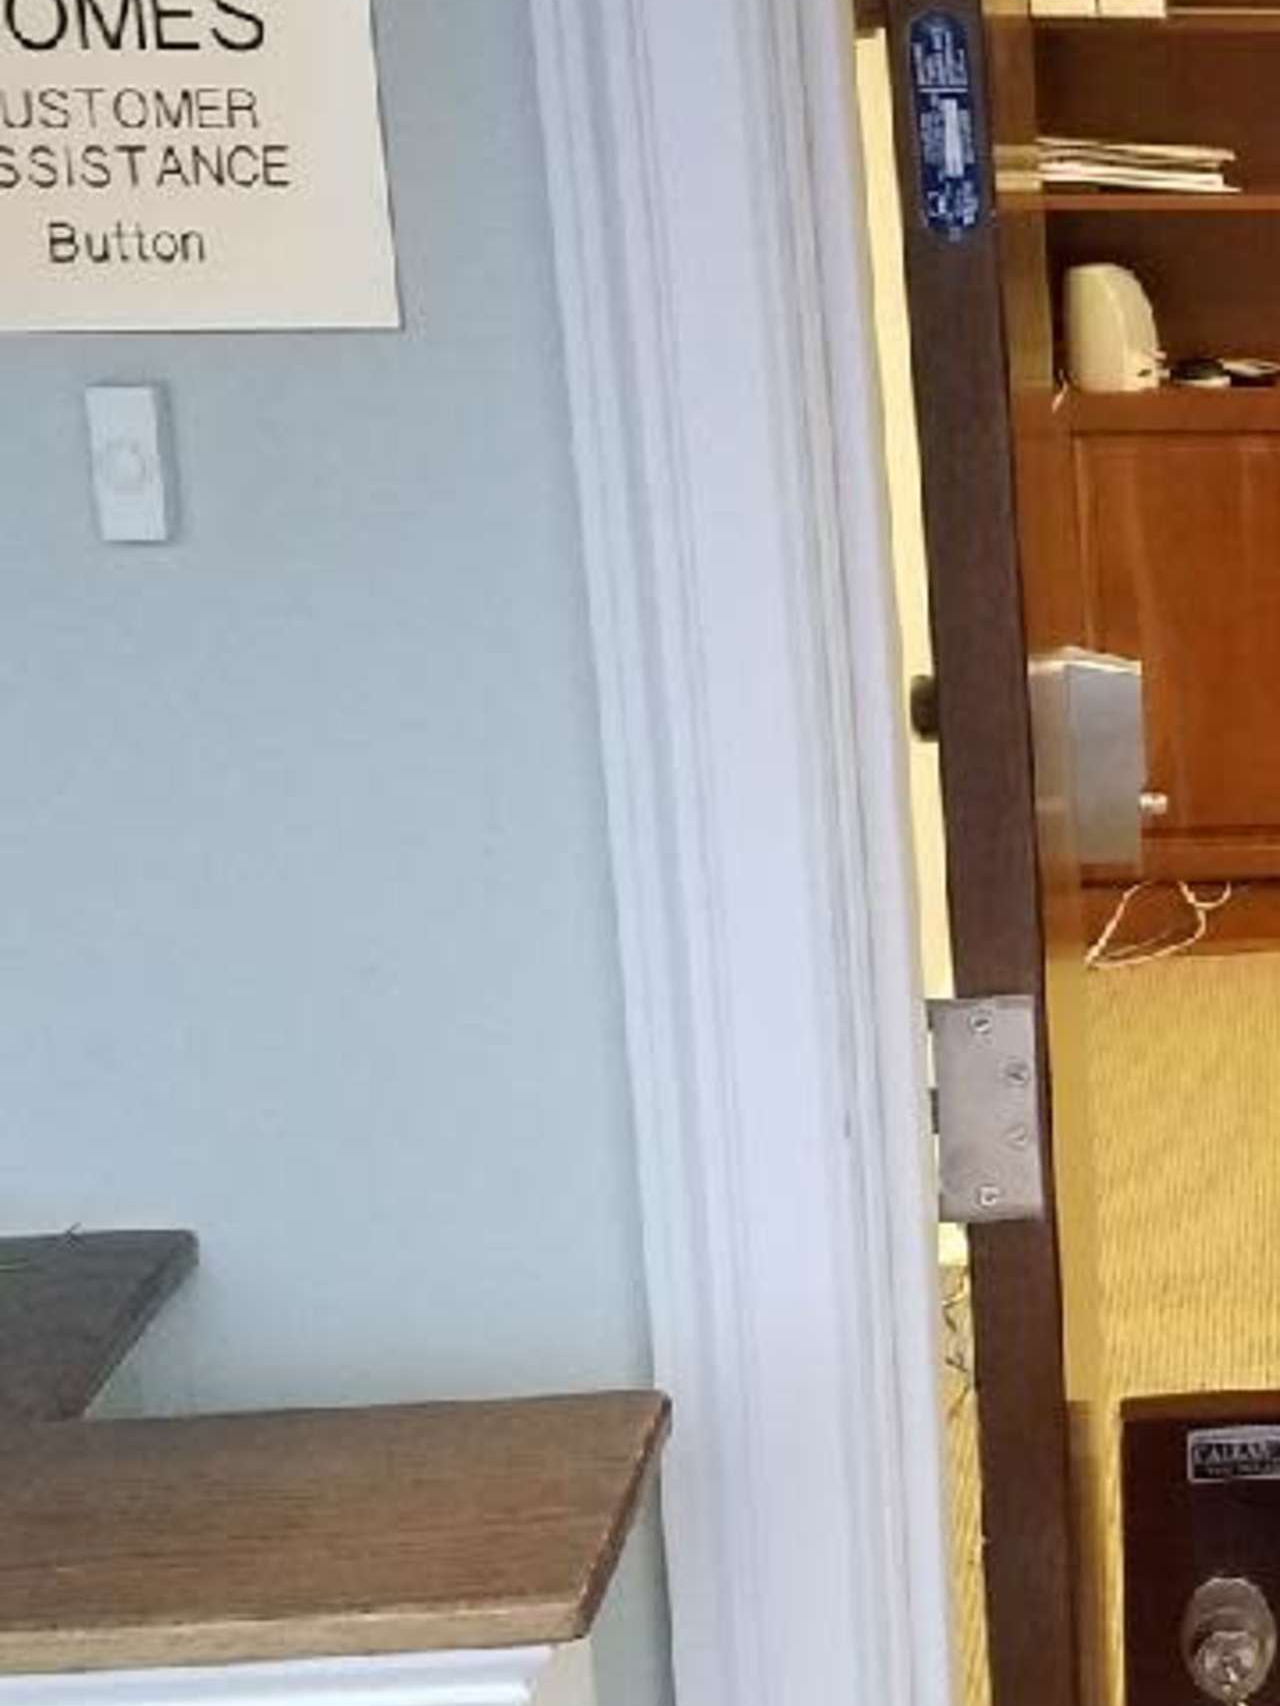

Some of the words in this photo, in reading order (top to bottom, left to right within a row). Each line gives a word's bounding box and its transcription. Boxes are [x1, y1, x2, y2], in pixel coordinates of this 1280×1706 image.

[1, 88, 259, 128] USTOMER
[0, 144, 290, 188] SSISTANCE
[48, 220, 206, 263] Button
